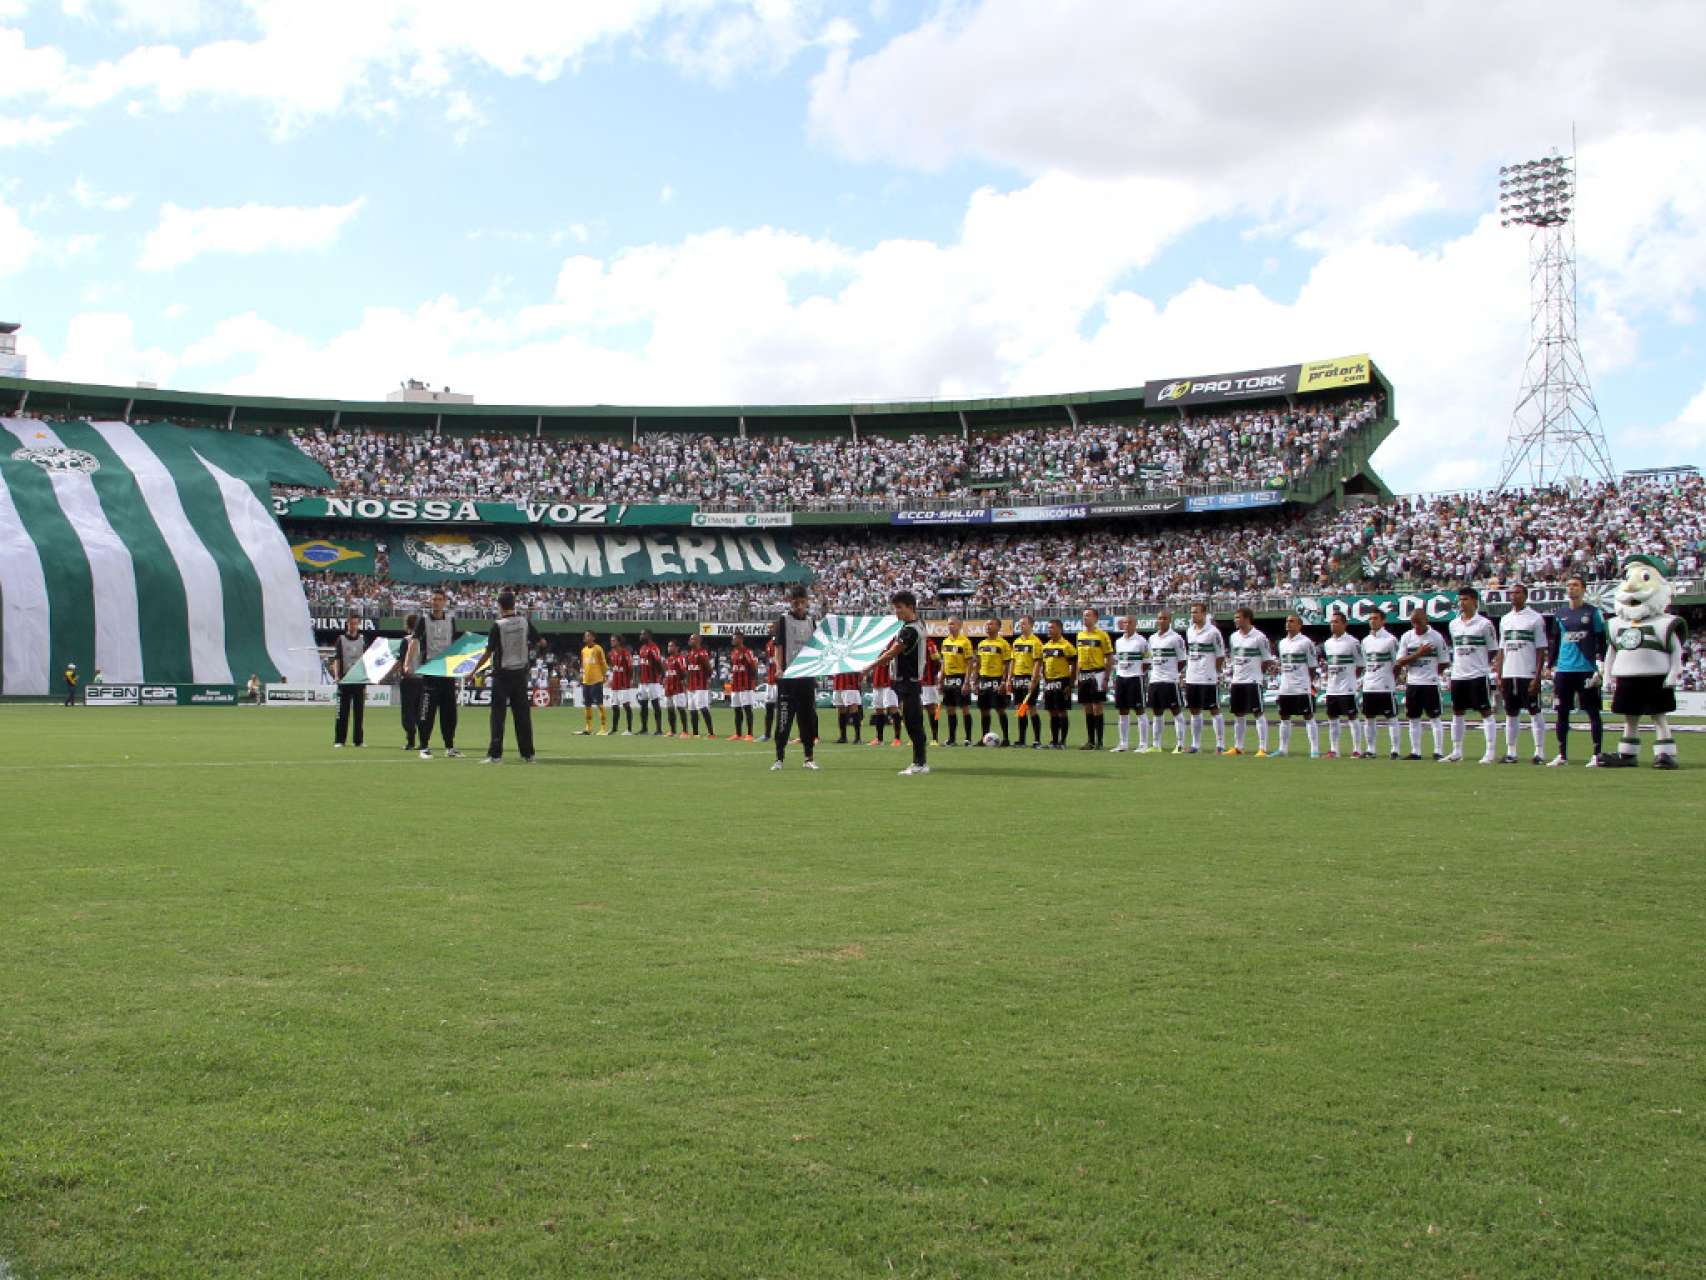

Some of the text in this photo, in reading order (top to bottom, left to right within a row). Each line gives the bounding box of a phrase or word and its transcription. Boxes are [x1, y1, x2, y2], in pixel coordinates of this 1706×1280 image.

[1190, 380, 1231, 395] PRO
[1234, 373, 1286, 391] TORK
[324, 498, 480, 521] NOSSA
[519, 533, 785, 577] IMPERIO
